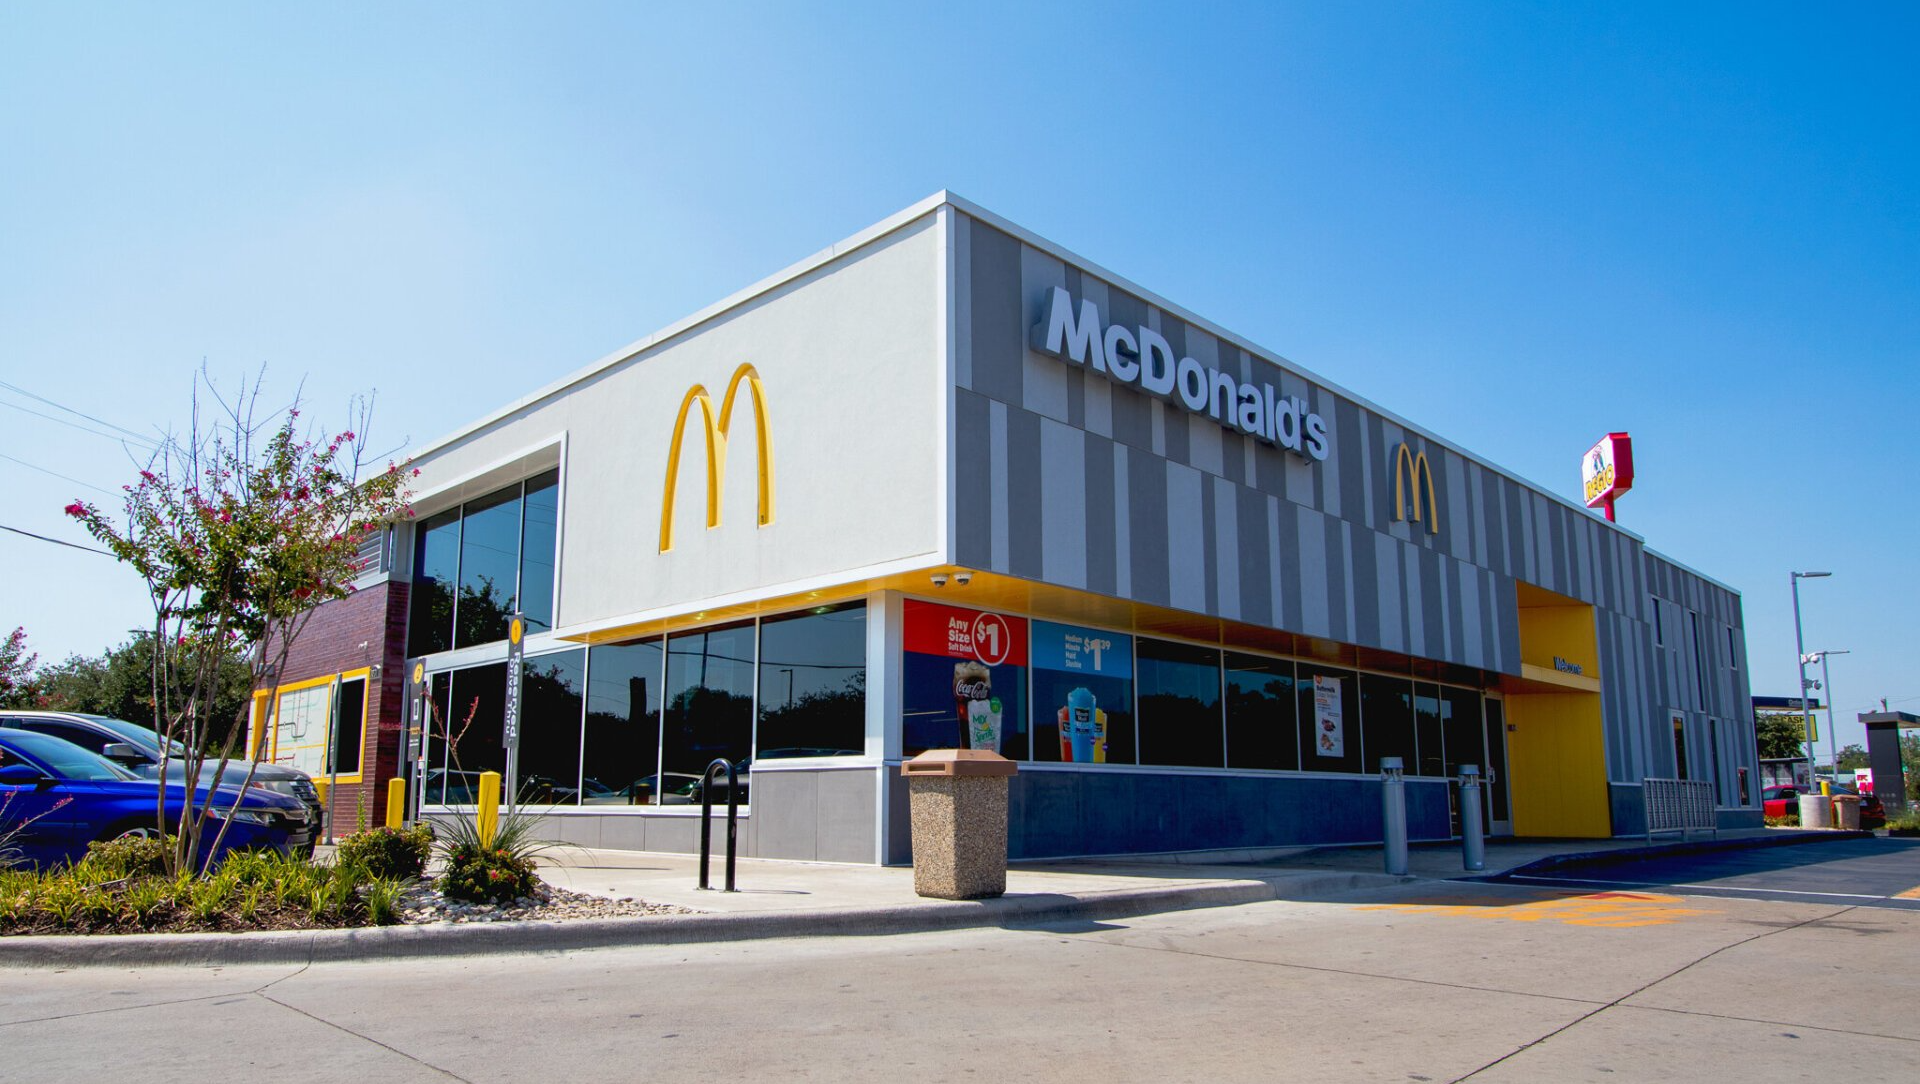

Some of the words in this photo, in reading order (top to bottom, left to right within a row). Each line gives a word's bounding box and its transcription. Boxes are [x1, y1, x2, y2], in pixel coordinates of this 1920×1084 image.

[1046, 284, 1329, 461] McDonald's
[1586, 464, 1613, 502] REGIO
[949, 617, 969, 632] Any
[949, 630, 970, 643] Size
[949, 642, 959, 651] Soft
[960, 644, 973, 653] Drink
[977, 621, 998, 656] $1
[510, 652, 521, 738] Reserved
[956, 679, 989, 699] Coca-Cola
